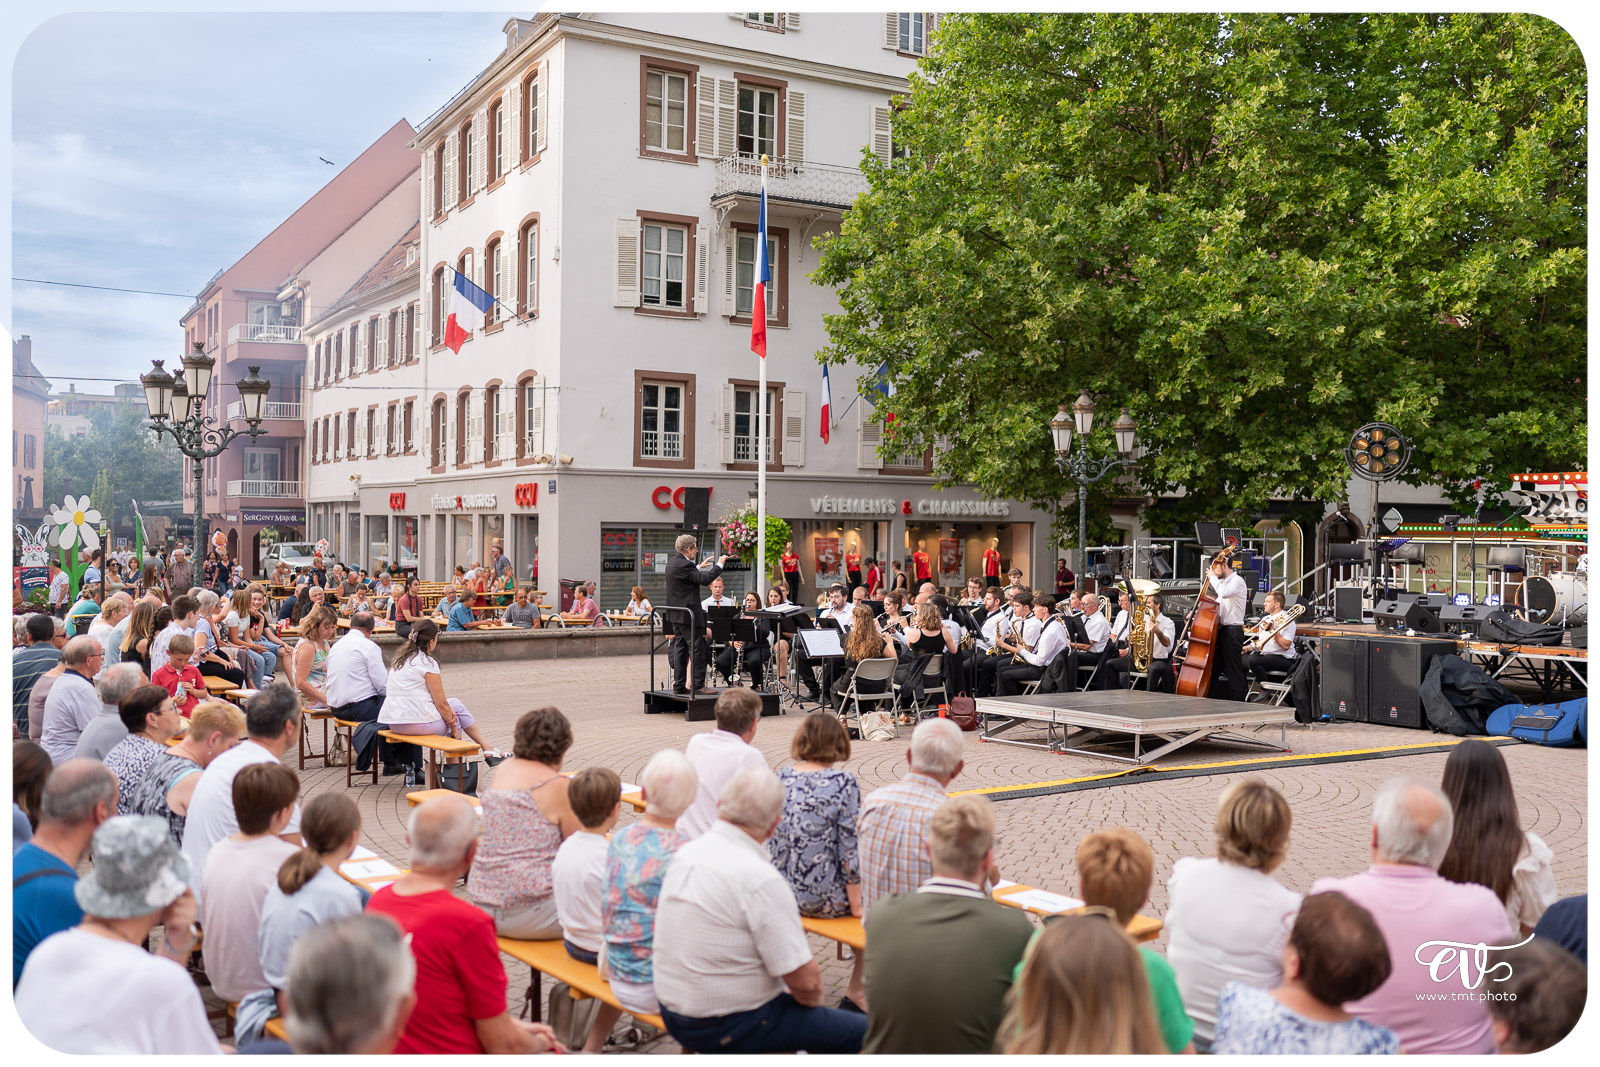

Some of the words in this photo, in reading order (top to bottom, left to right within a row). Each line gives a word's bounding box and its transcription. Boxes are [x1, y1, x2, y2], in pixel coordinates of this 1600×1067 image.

[389, 492, 407, 510] CCV
[514, 482, 539, 506] CCV
[651, 485, 714, 510] CC
[810, 495, 897, 514] VÊTEMENTS
[901, 499, 913, 515] &
[917, 500, 1010, 517] CHAUSSURES
[603, 533, 636, 546] CCV
[604, 561, 634, 569] OUVERT
